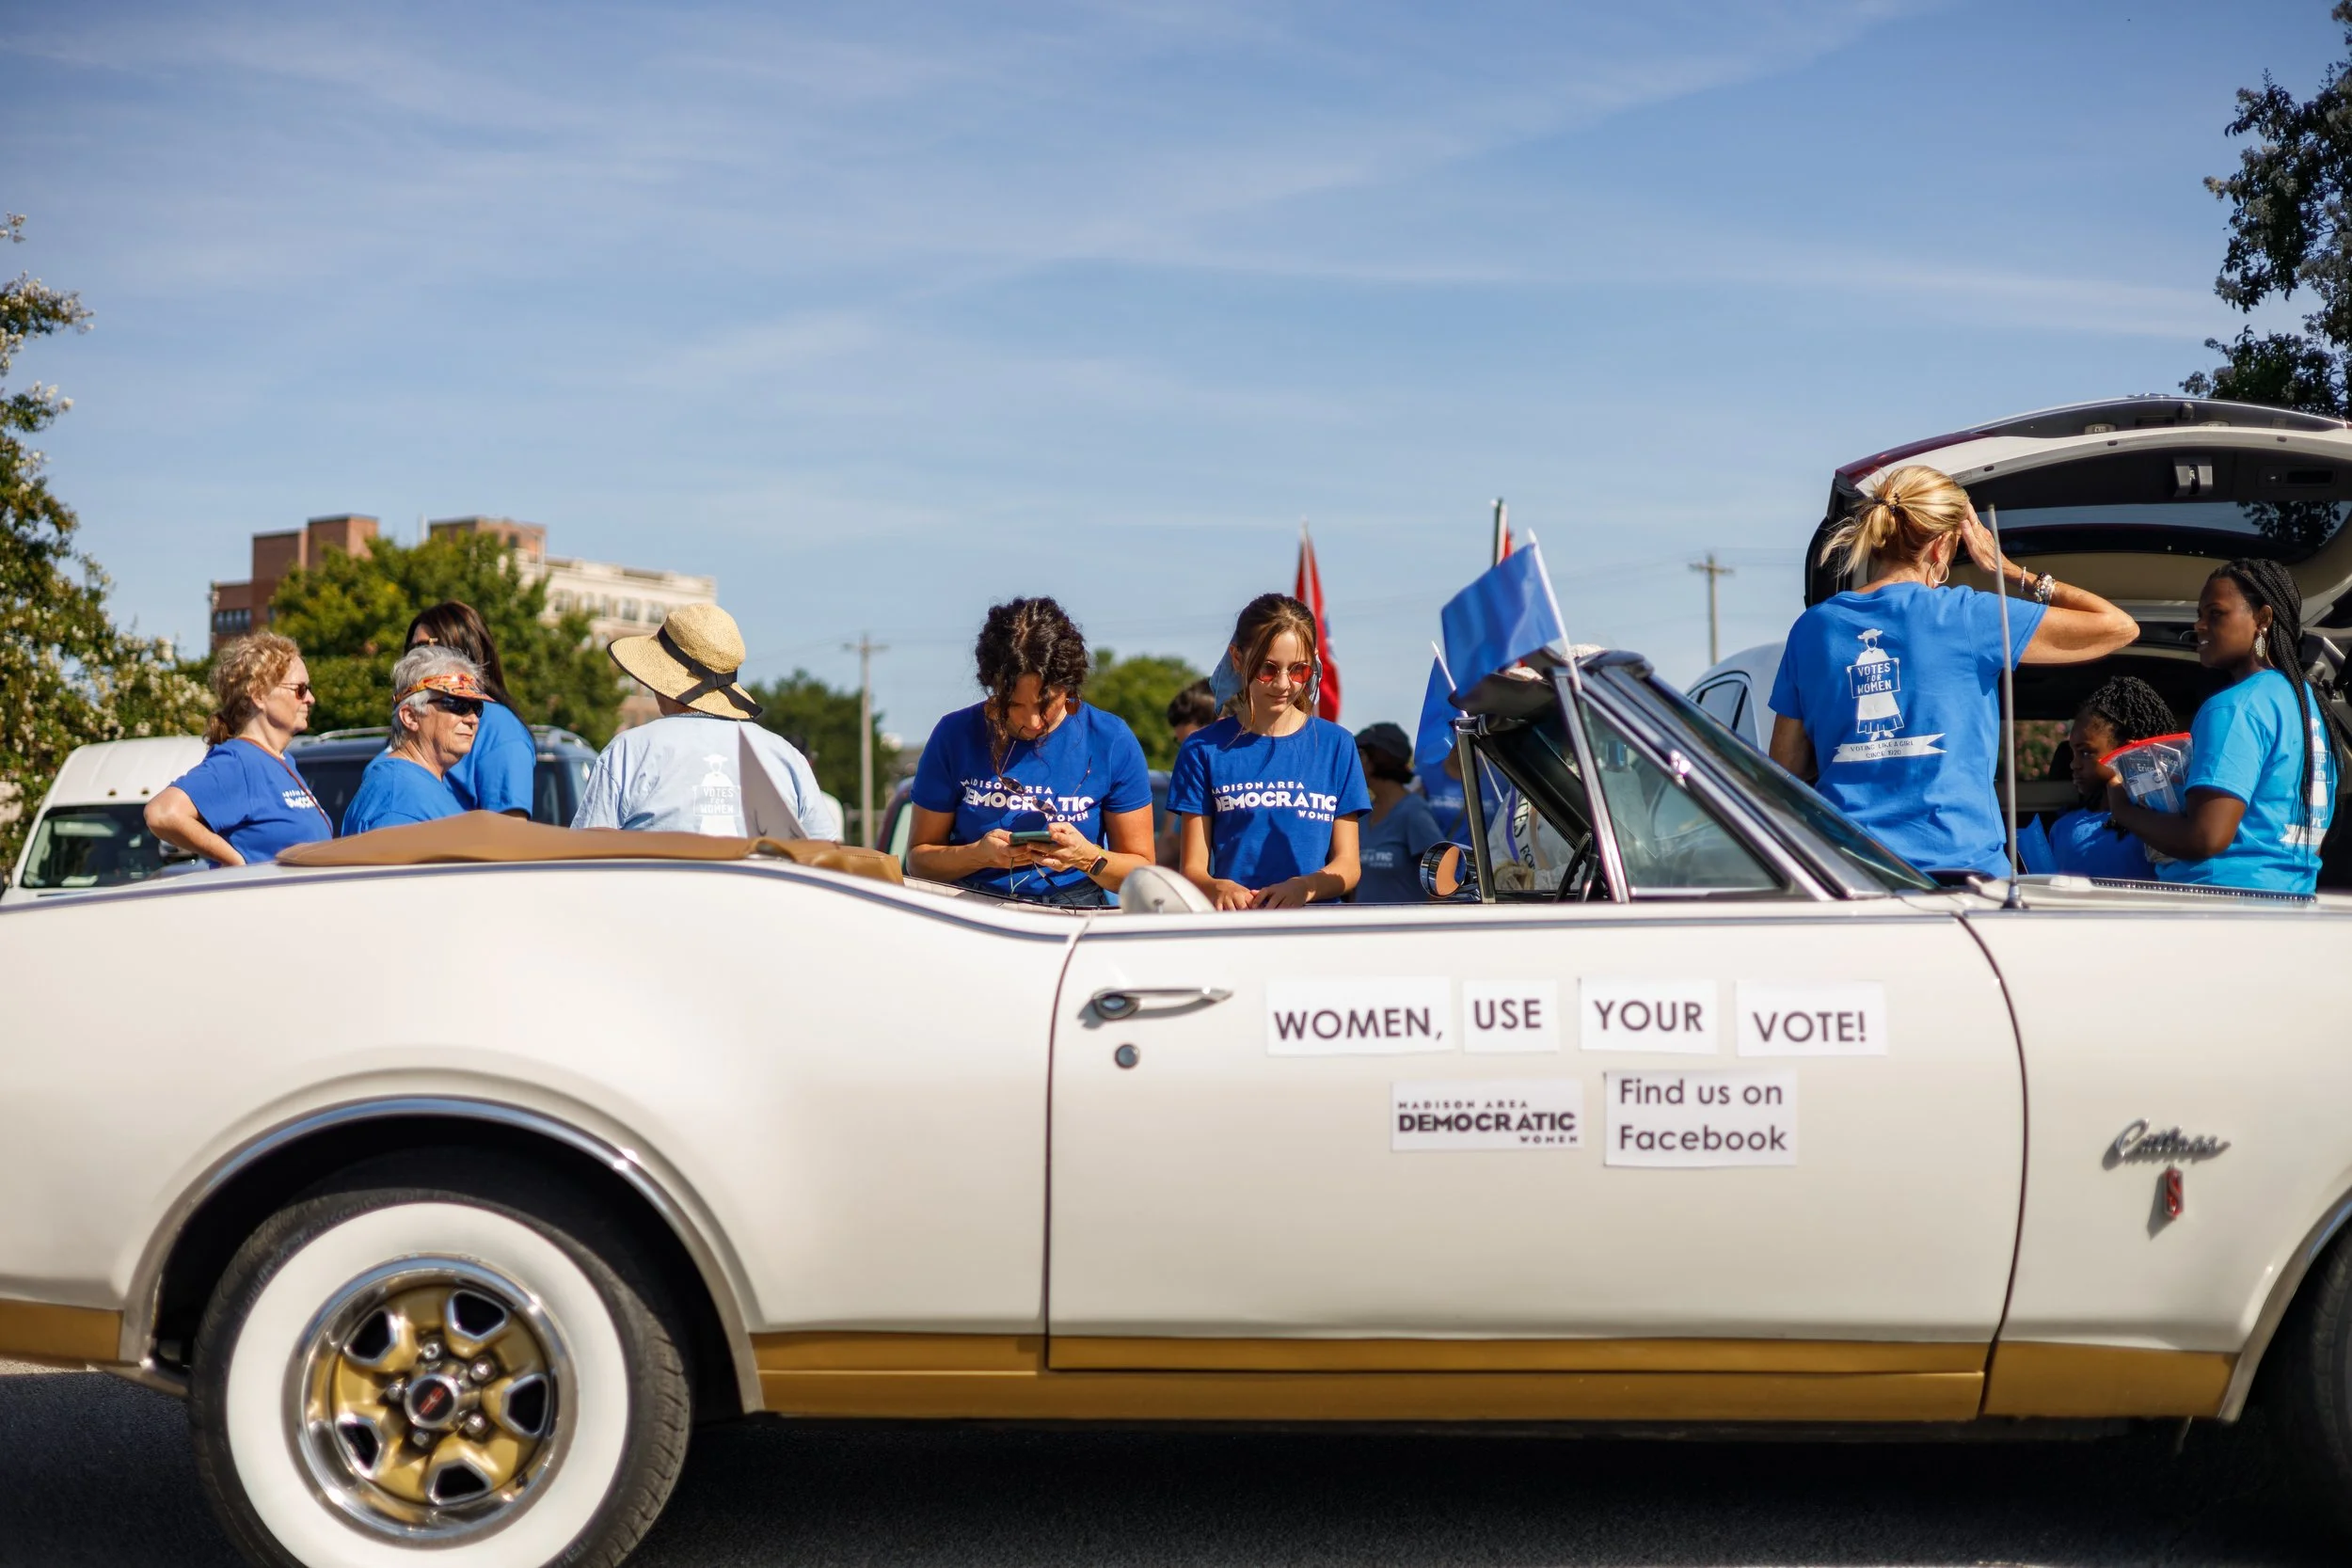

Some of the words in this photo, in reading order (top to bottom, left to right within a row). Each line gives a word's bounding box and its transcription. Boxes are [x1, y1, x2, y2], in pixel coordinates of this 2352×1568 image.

[1857, 662, 1891, 677] VOTES
[1867, 673, 1882, 683] FOR
[1857, 679, 1892, 694] WOMEN
[1850, 744, 1875, 752] VOTING
[1267, 781, 1306, 789] AREA
[703, 787, 734, 798] VOTES
[963, 786, 1095, 812] EMOCRATIC
[699, 804, 734, 815] WOMEN
[1044, 811, 1089, 822] WOMEN
[1274, 1006, 1443, 1041] WOMEN,
[1473, 998, 1543, 1031] USE
[1593, 999, 1705, 1033] YOUR
[1752, 1009, 1868, 1043] VOTE!
[1619, 1077, 1685, 1105] Find
[1697, 1085, 1731, 1105] us
[1741, 1085, 1783, 1105] on
[1397, 1100, 1476, 1110] MADISON
[1485, 1099, 1529, 1109] AREA
[1397, 1111, 1577, 1132] DEMOCRATIC
[1518, 1134, 1579, 1144] WOMEN
[1619, 1124, 1788, 1151] Facebook
